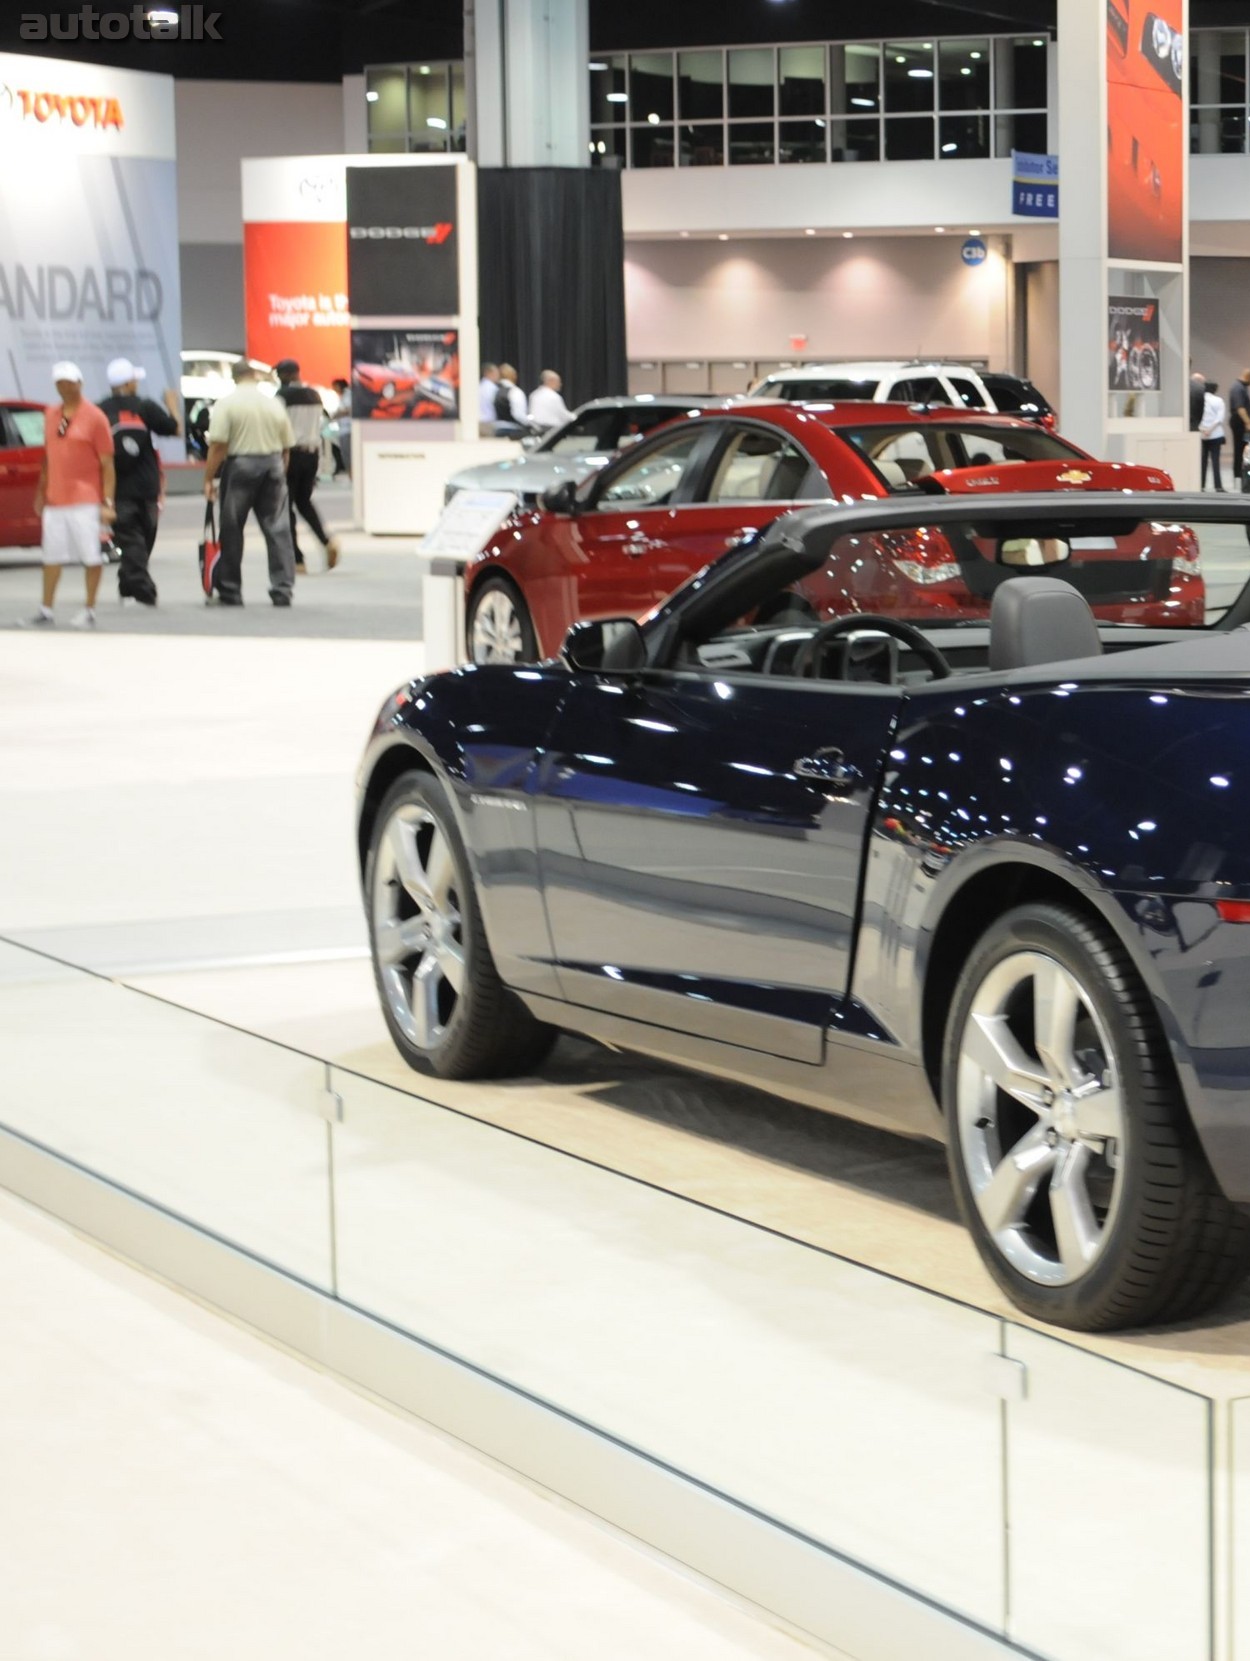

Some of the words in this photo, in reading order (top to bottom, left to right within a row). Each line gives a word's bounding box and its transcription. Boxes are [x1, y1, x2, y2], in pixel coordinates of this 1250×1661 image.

[17, 90, 125, 131] TOYOTA
[1019, 192, 1055, 207] FREE
[350, 226, 437, 239] DODGE
[268, 292, 316, 315] Toyota
